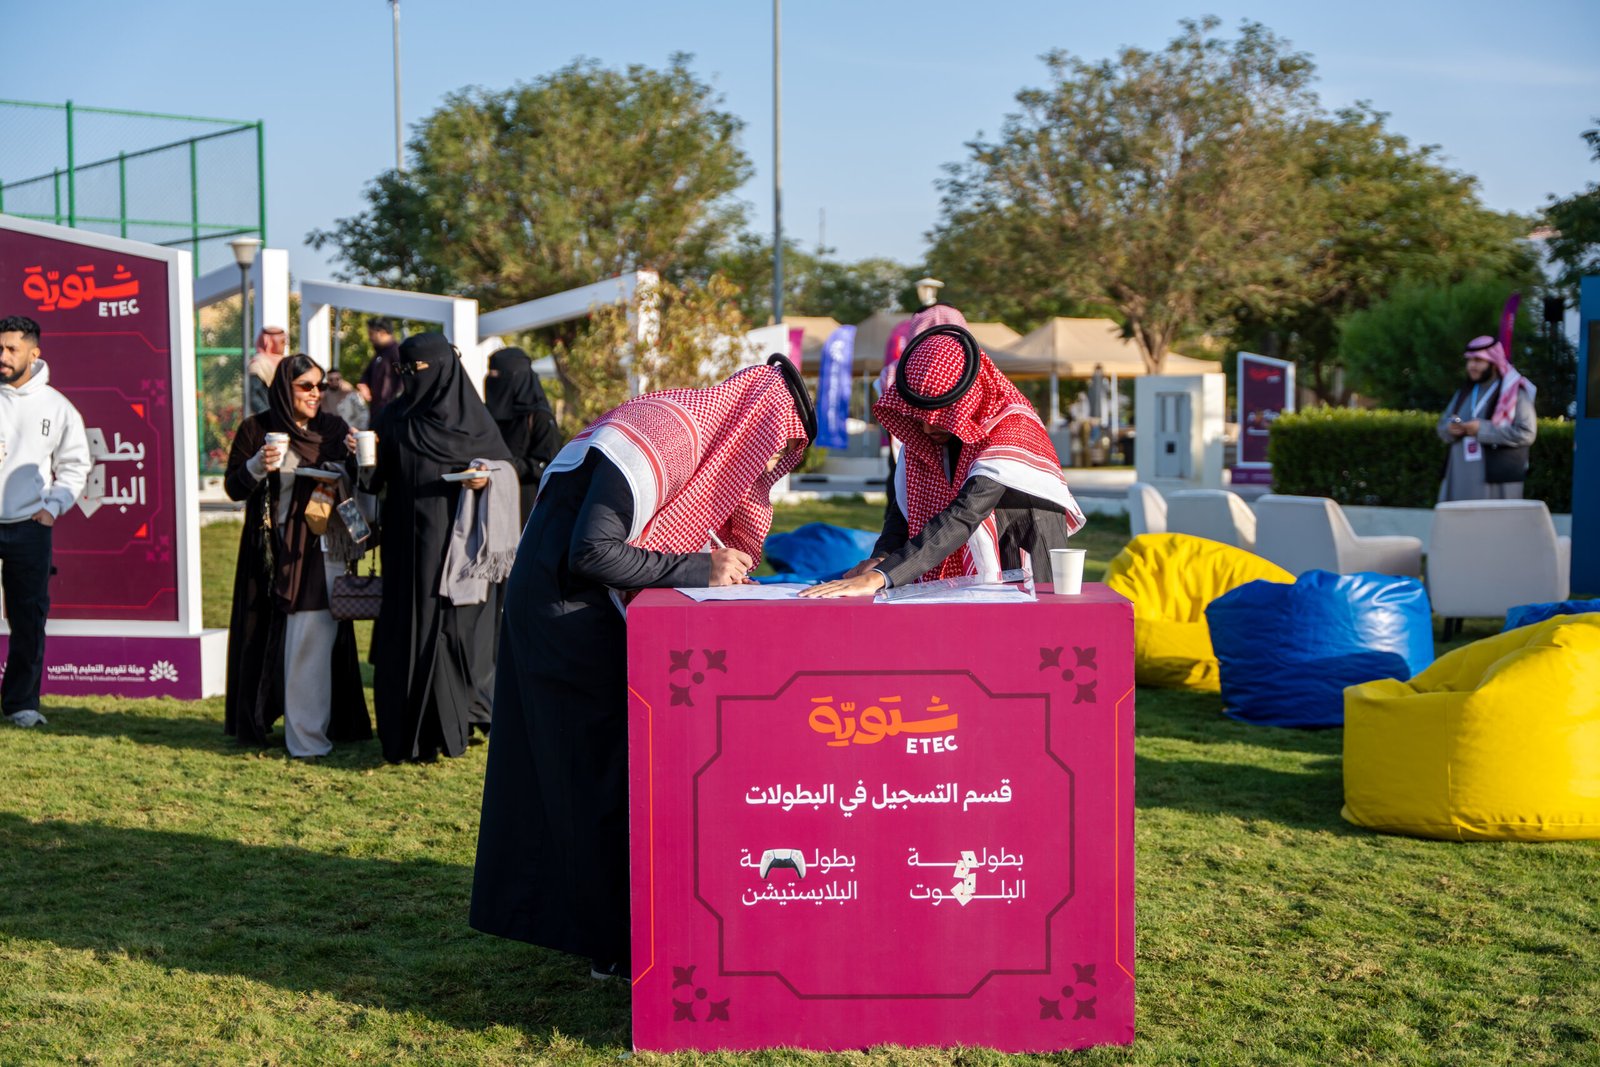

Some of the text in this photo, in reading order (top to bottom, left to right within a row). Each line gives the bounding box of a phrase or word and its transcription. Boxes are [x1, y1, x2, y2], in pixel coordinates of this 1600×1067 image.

[98, 299, 140, 317] ETEC
[47, 663, 146, 676] هيئة تقويم التعليم والتدريب
[906, 735, 959, 754] ETEC
[745, 778, 1013, 817] قسم التسجيل في البطولات
[741, 880, 858, 906] البلايستيشن
